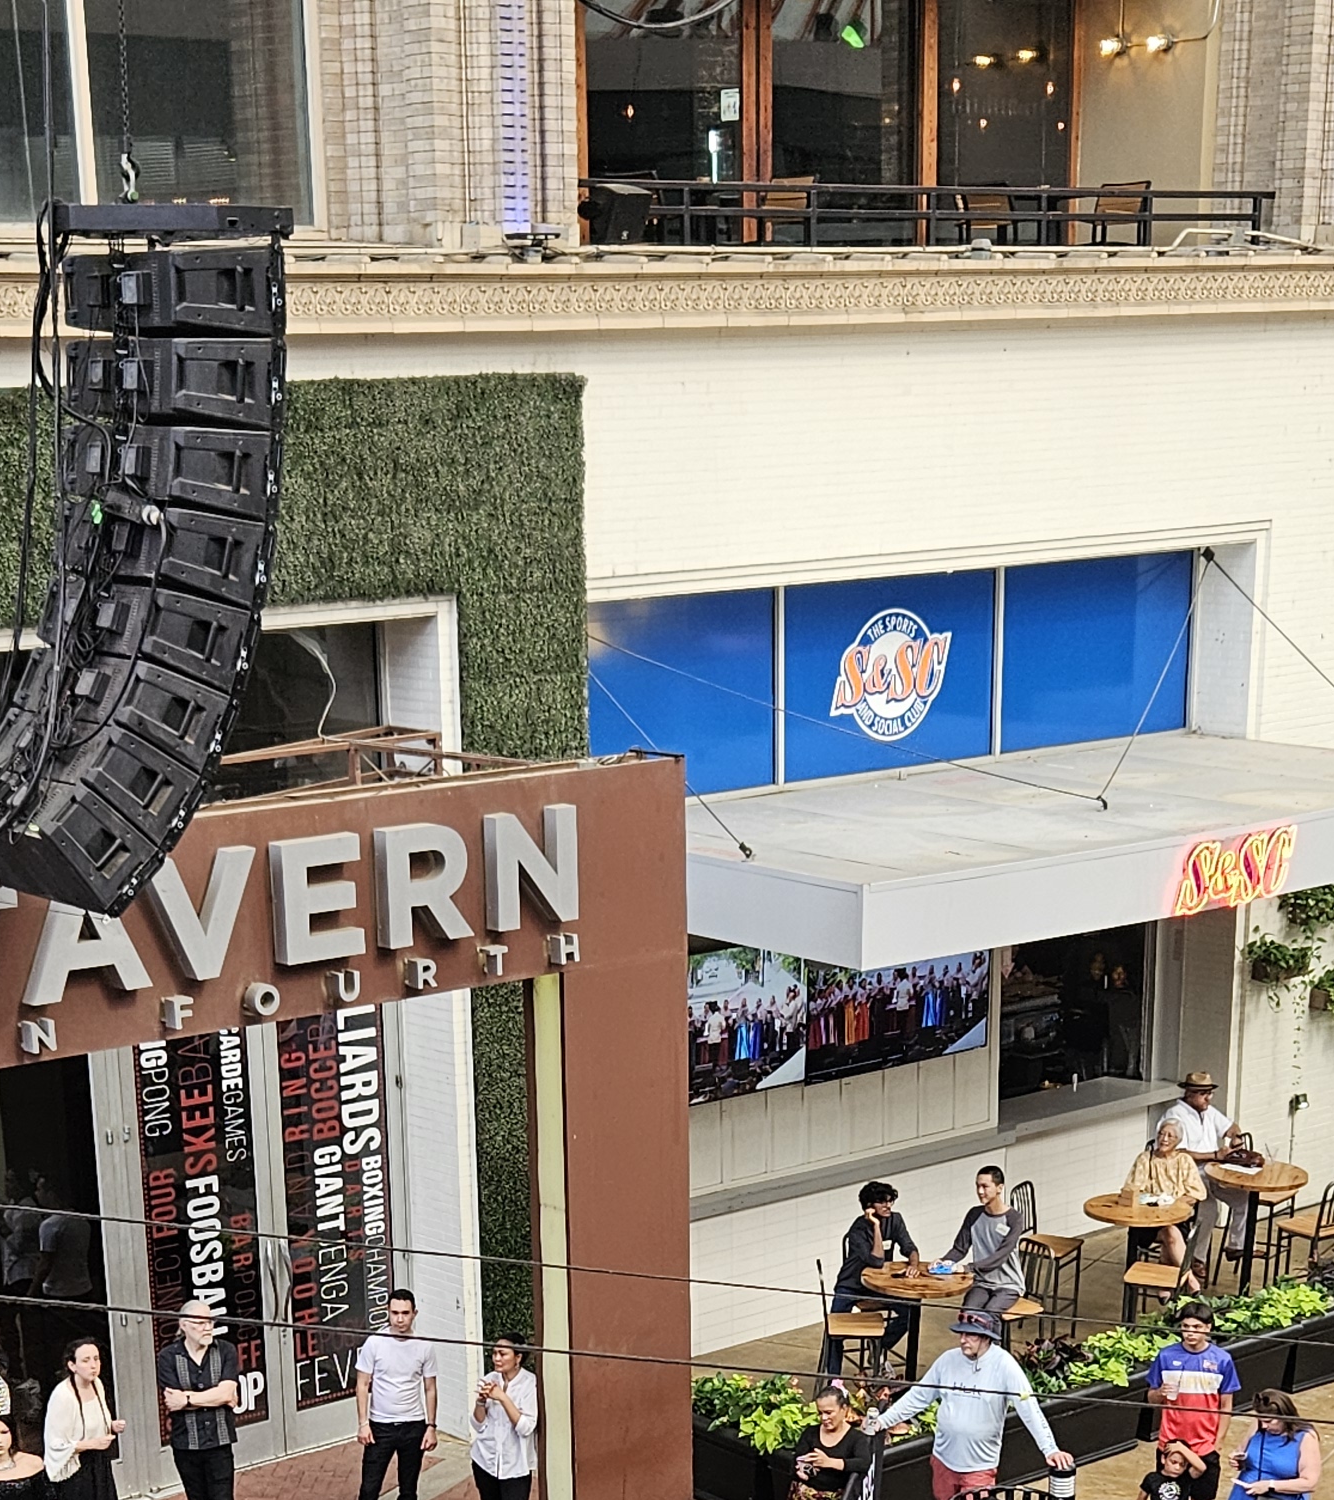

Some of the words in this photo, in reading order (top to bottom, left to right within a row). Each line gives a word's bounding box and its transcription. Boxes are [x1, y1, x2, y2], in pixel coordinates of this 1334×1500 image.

[867, 620, 886, 642] THE
[885, 616, 919, 638] SPORTS
[834, 636, 949, 711] S&SC
[856, 701, 875, 724] AND
[872, 718, 905, 735] SOCIAL
[904, 701, 926, 726] CLUB
[1173, 824, 1298, 915] S&SC
[161, 932, 581, 1030] FOURTH
[149, 1167, 179, 1240] FOUR
[313, 1144, 346, 1231] GIANT
[230, 1212, 254, 1269] BAR
